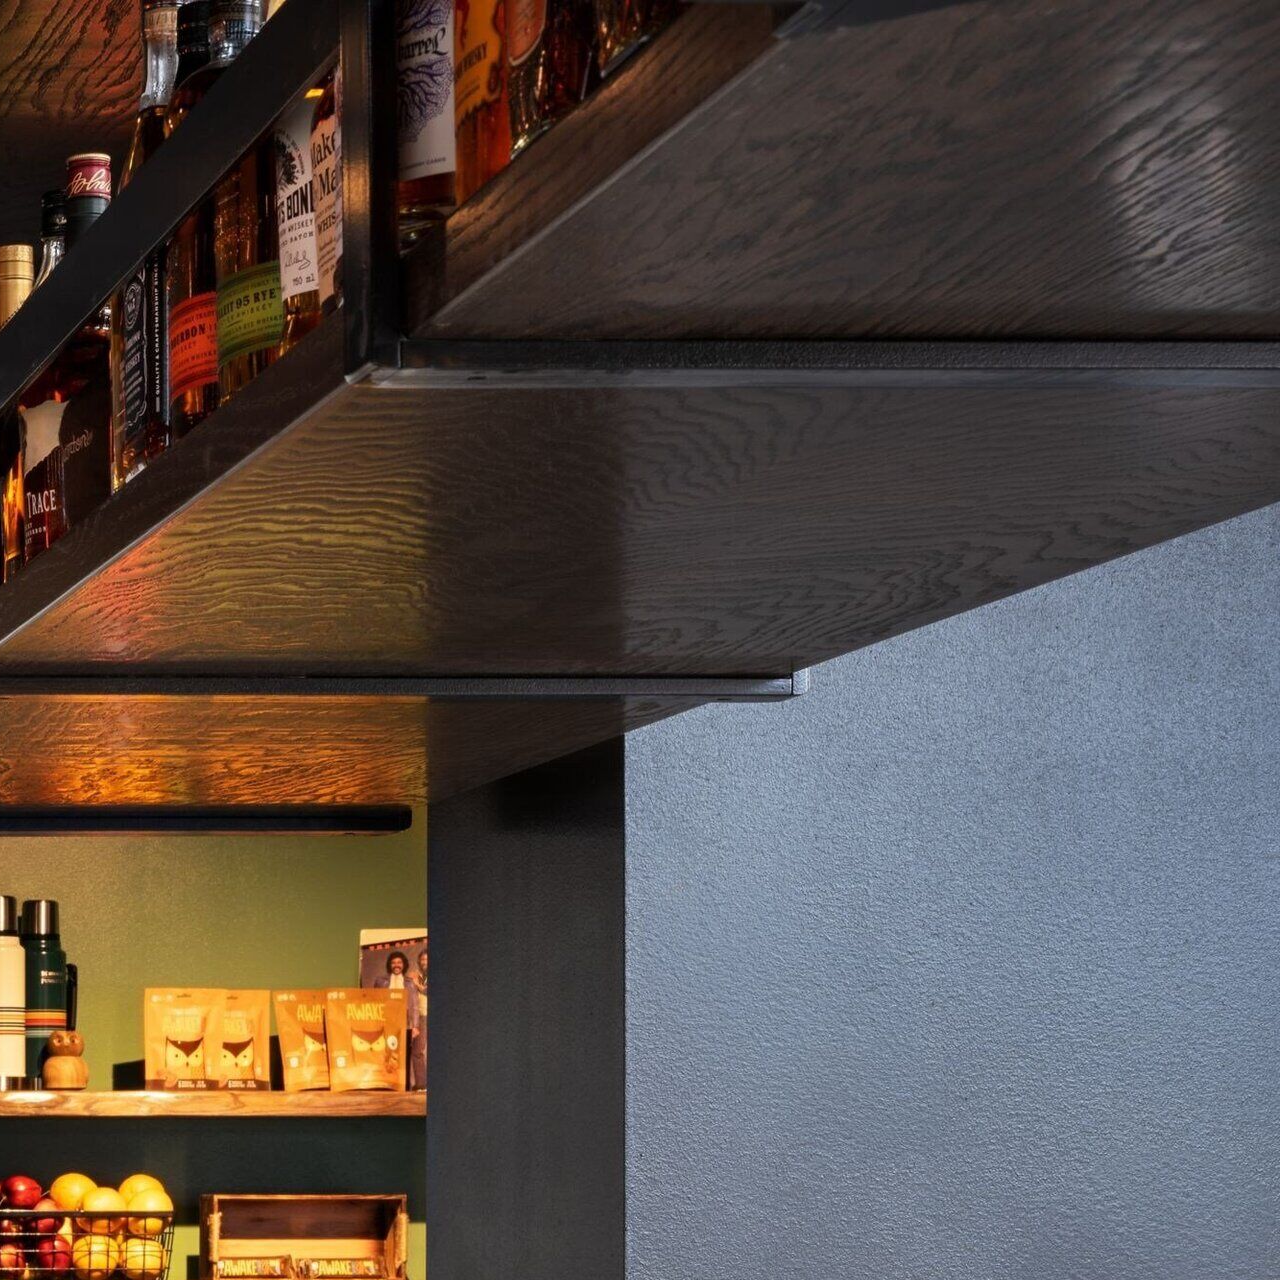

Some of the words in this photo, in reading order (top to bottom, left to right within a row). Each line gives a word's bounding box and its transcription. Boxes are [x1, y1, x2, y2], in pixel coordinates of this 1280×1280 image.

[253, 288, 277, 303] RYE
[26, 488, 57, 518] TRACE
[297, 1004, 323, 1022] AWA
[346, 1003, 386, 1021] AWAKE
[223, 1260, 257, 1276] AWAKE
[318, 1260, 352, 1276] AWAKE
